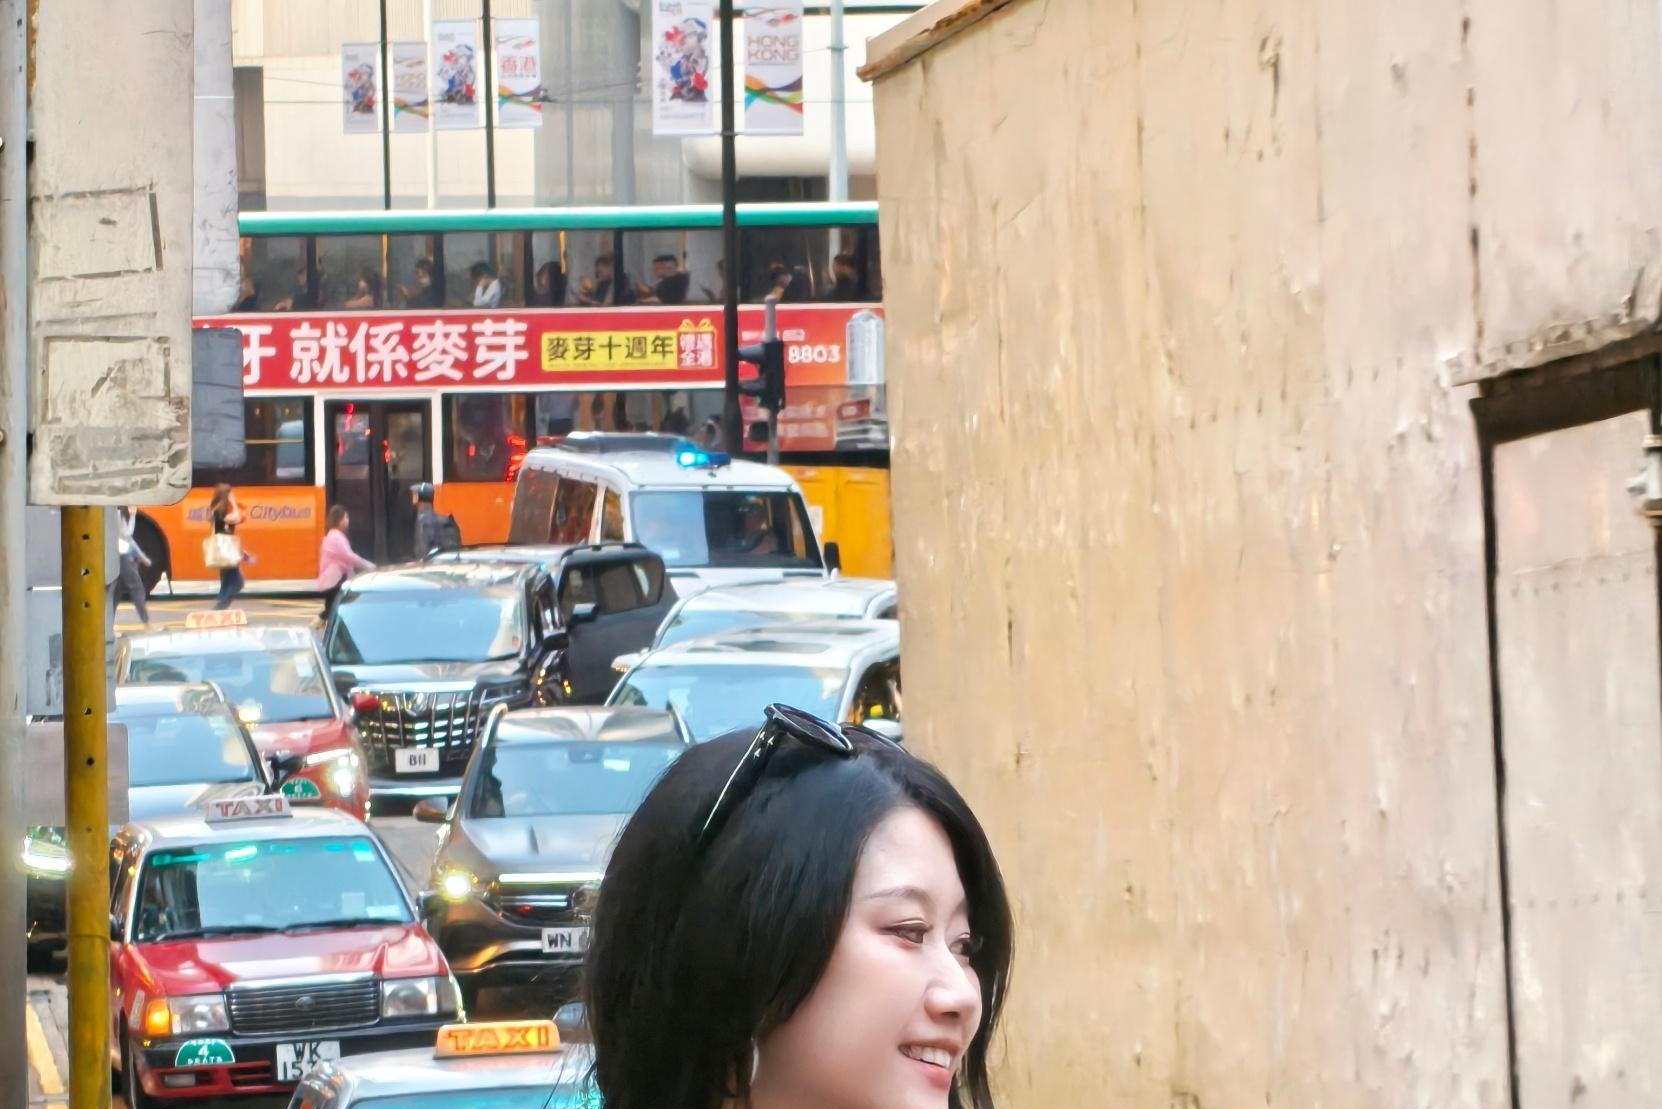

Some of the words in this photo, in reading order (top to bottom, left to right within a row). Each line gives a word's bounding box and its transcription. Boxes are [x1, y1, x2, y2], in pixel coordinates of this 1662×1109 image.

[747, 35, 800, 48] HONG
[747, 49, 800, 61] KONG
[289, 318, 529, 384] 就係麥芽
[547, 334, 674, 361] 麥芽十週年
[788, 344, 841, 364] 8803
[191, 611, 241, 627] TAXI
[215, 798, 283, 817] TAXI
[447, 1025, 550, 1052] TAXI
[198, 1044, 210, 1058] 4
[292, 1040, 322, 1061] WK
